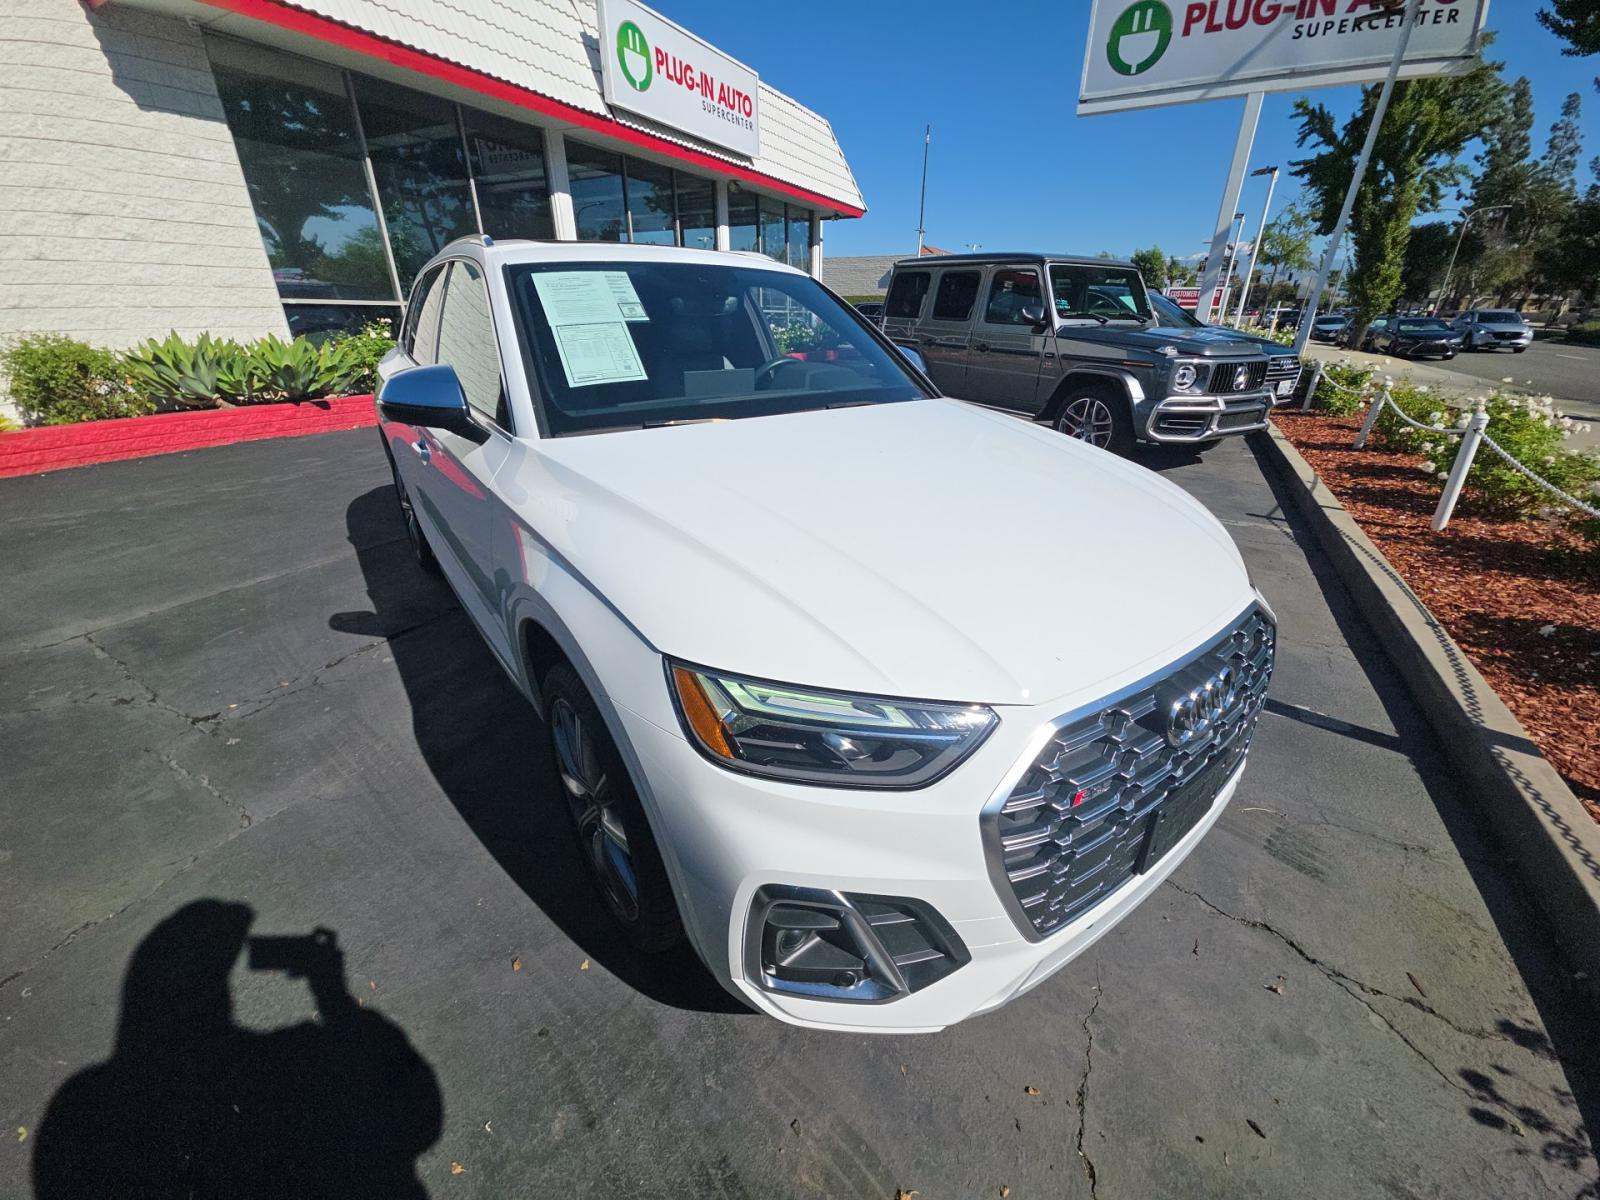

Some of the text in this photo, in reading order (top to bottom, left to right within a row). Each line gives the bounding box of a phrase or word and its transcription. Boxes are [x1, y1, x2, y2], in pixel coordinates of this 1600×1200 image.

[1292, 8, 1460, 40] SUPERCETER
[655, 46, 752, 118] PLUG-IN AUTO
[702, 100, 754, 132] SUPERCENTER
[1170, 290, 1198, 298] CUSTOMER
